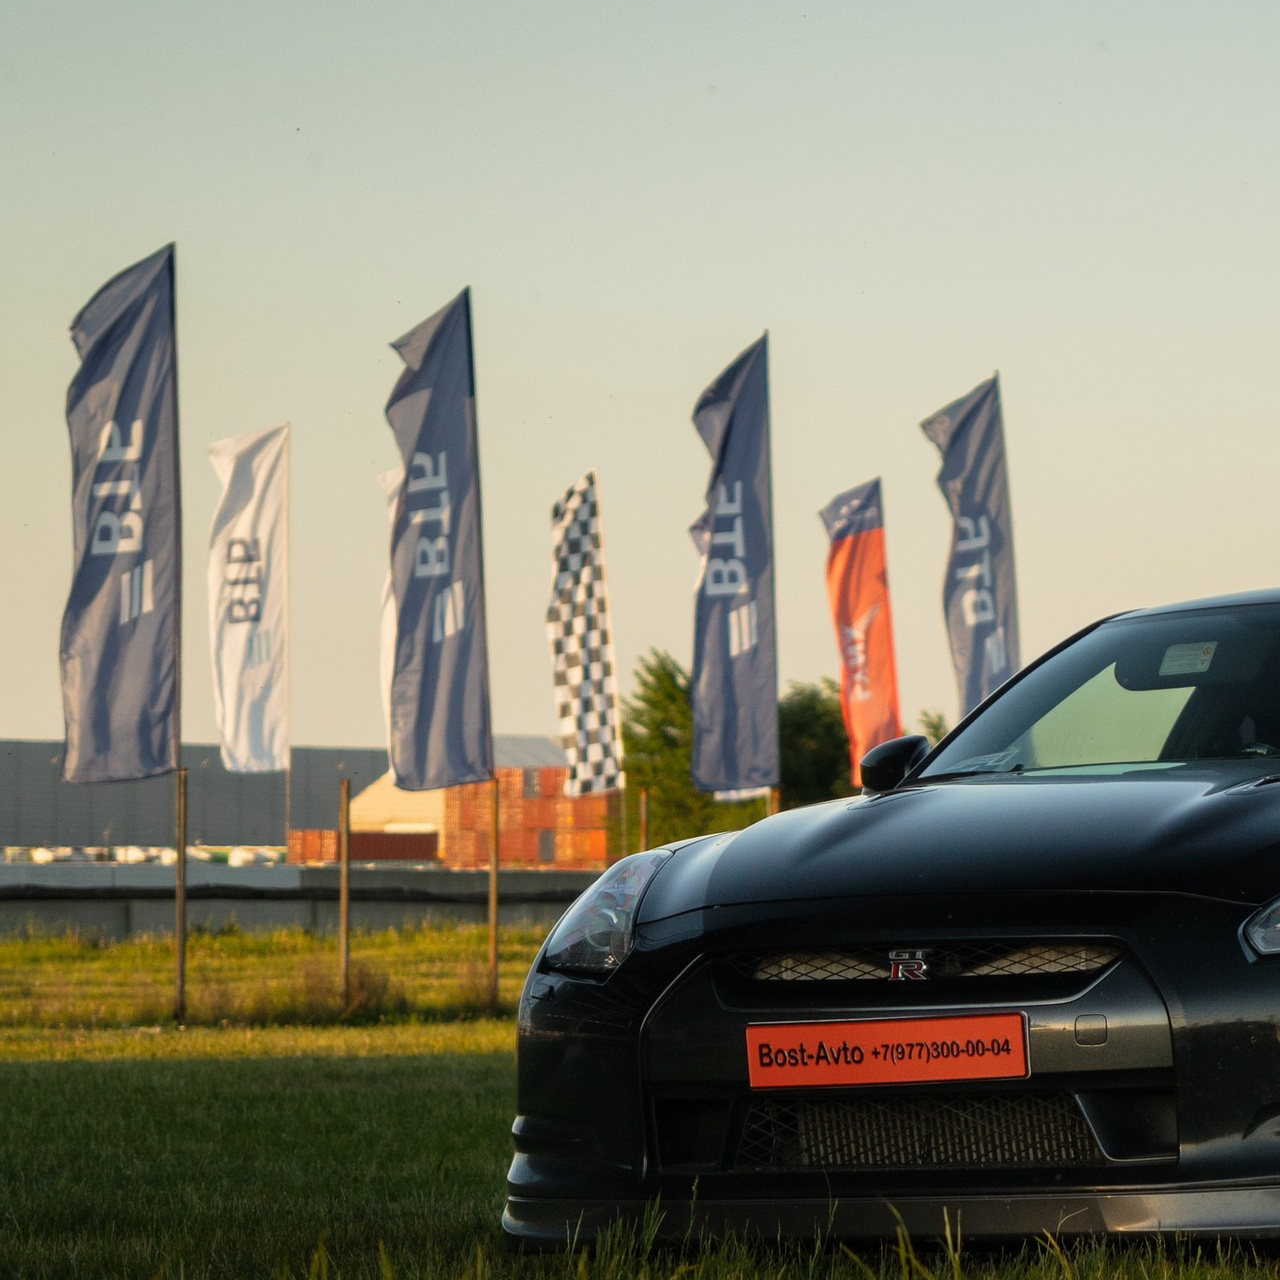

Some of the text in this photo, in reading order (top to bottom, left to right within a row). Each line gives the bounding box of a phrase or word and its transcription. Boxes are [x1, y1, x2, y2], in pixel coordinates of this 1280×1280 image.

[888, 948, 929, 959] GT
[888, 960, 928, 981] R
[759, 1038, 1011, 1067] Bost-Avto +7(977)300-00-04
